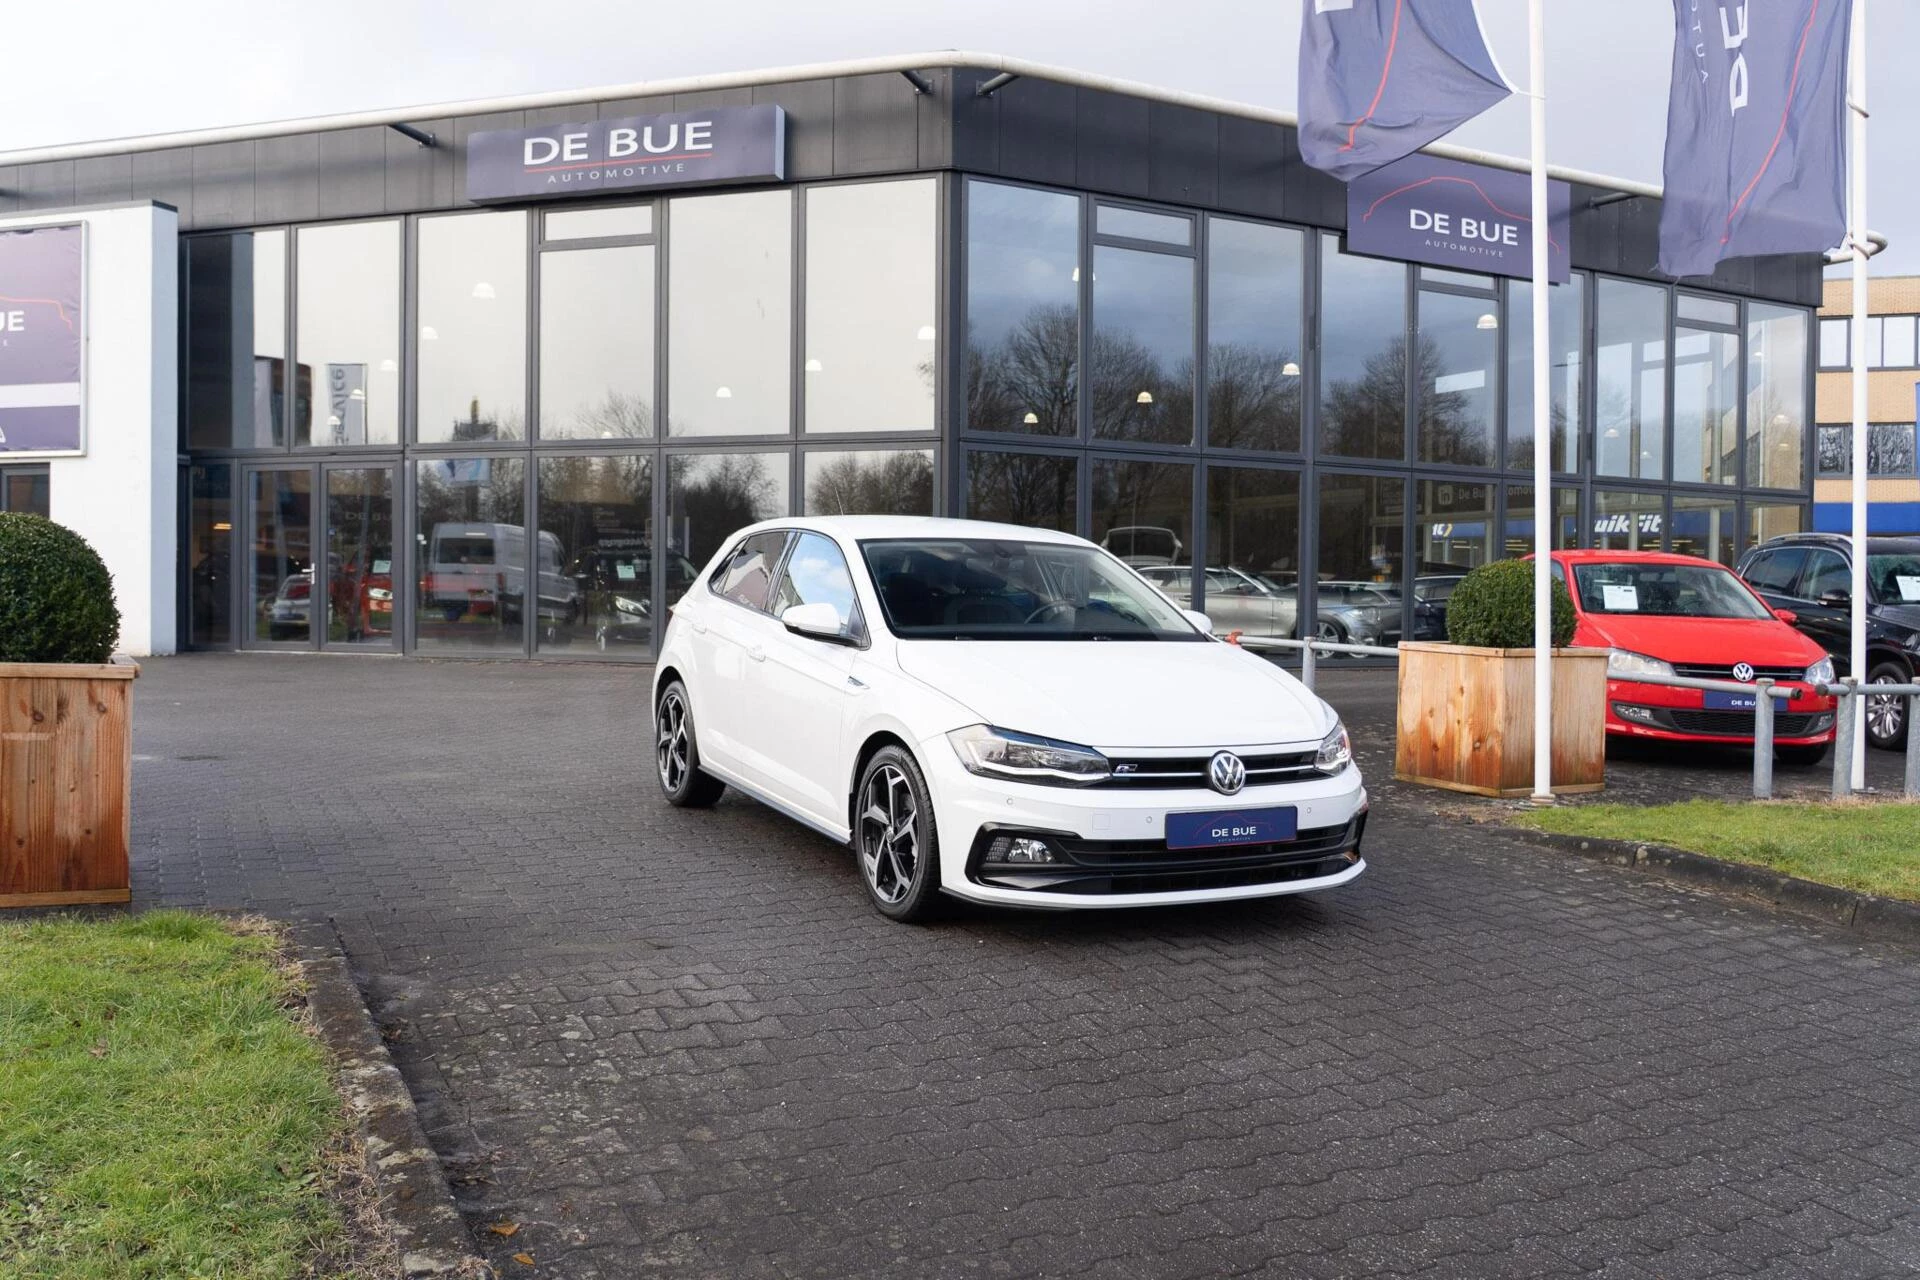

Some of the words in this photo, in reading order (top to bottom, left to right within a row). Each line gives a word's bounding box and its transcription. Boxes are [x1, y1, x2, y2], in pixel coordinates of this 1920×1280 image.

[523, 132, 588, 166] DE
[608, 121, 713, 158] BUE
[547, 163, 685, 184] AUTOMOTIVE
[1409, 208, 1450, 235] DE
[1461, 217, 1518, 246] BUE
[1424, 239, 1504, 258] AUTOMOTIVE
[1211, 828, 1229, 838] DE
[1232, 826, 1257, 837] BUE
